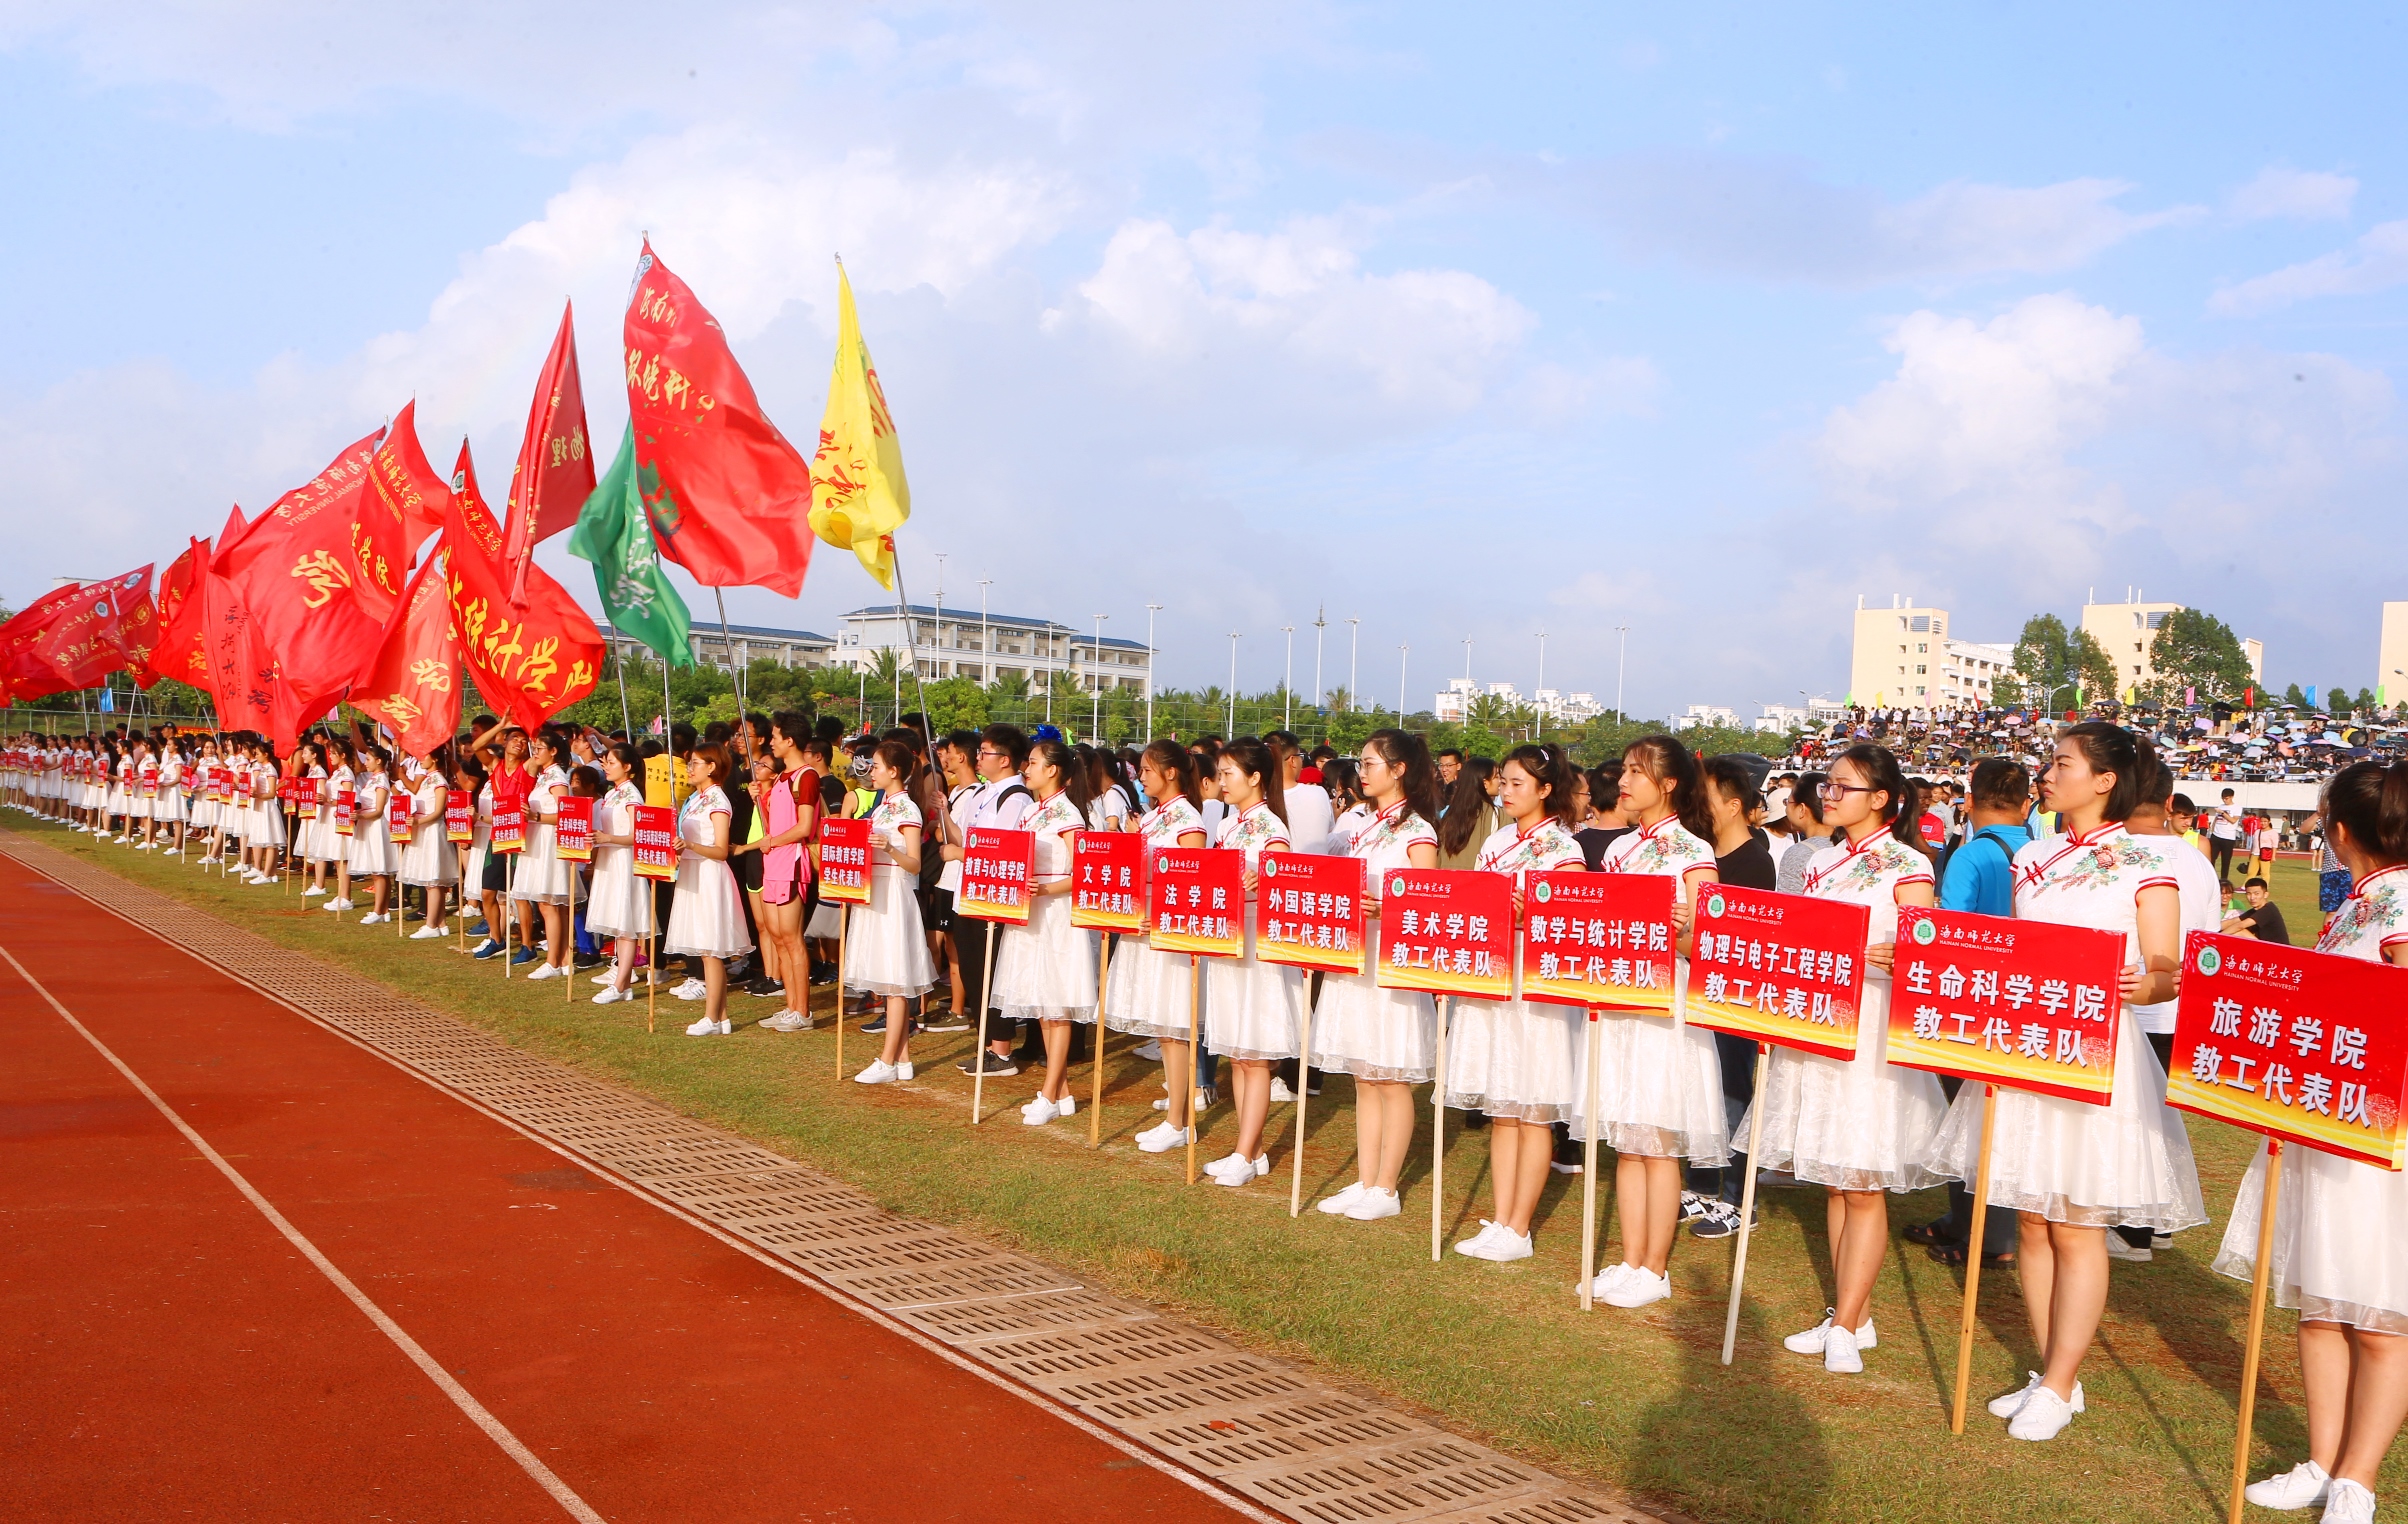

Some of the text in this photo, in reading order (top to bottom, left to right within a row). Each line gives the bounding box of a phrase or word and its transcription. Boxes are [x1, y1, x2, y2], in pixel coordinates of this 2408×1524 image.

[637, 848, 668, 867] 学生代表队
[821, 844, 865, 866] 国际教育学院
[964, 856, 1026, 882] 教育与心理学院
[823, 868, 862, 888] 学生代表队
[1083, 862, 1131, 888] 文学院
[1406, 880, 1452, 894] 海南师范大学
[966, 881, 1020, 906] 教工代表队
[1078, 889, 1134, 915] 教工代表队
[1164, 883, 1226, 910] 法学院
[1268, 888, 1351, 920] 外国语学院
[1553, 884, 1605, 899] 海南师范大学
[1727, 899, 1785, 921] 海南师范大学
[1159, 911, 1230, 940] 教工代表队
[1267, 918, 1350, 952] 教工代表队
[1401, 909, 1489, 943] 美术学院
[1530, 914, 1669, 953] 数学与统计学院
[1939, 924, 2016, 947] 海南师范大学
[1391, 942, 1494, 979] 教工代表队
[1699, 930, 1854, 987] 物理与电子工程学院
[1939, 939, 2014, 954] HAINAN NORMAL UNIVERSITY
[1539, 951, 1658, 990] 教工代表队
[2223, 970, 2300, 992] HAINAN NORMAL UNIVERSITY
[2224, 954, 2303, 984] 海南师范大学
[1704, 971, 1837, 1028] 教工代表队
[1905, 960, 2107, 1023] 生命科学学院
[1912, 1004, 2088, 1068] 教工代表队
[2208, 996, 2369, 1070] 旅游学院
[2191, 1042, 2371, 1129] 教工代表队
